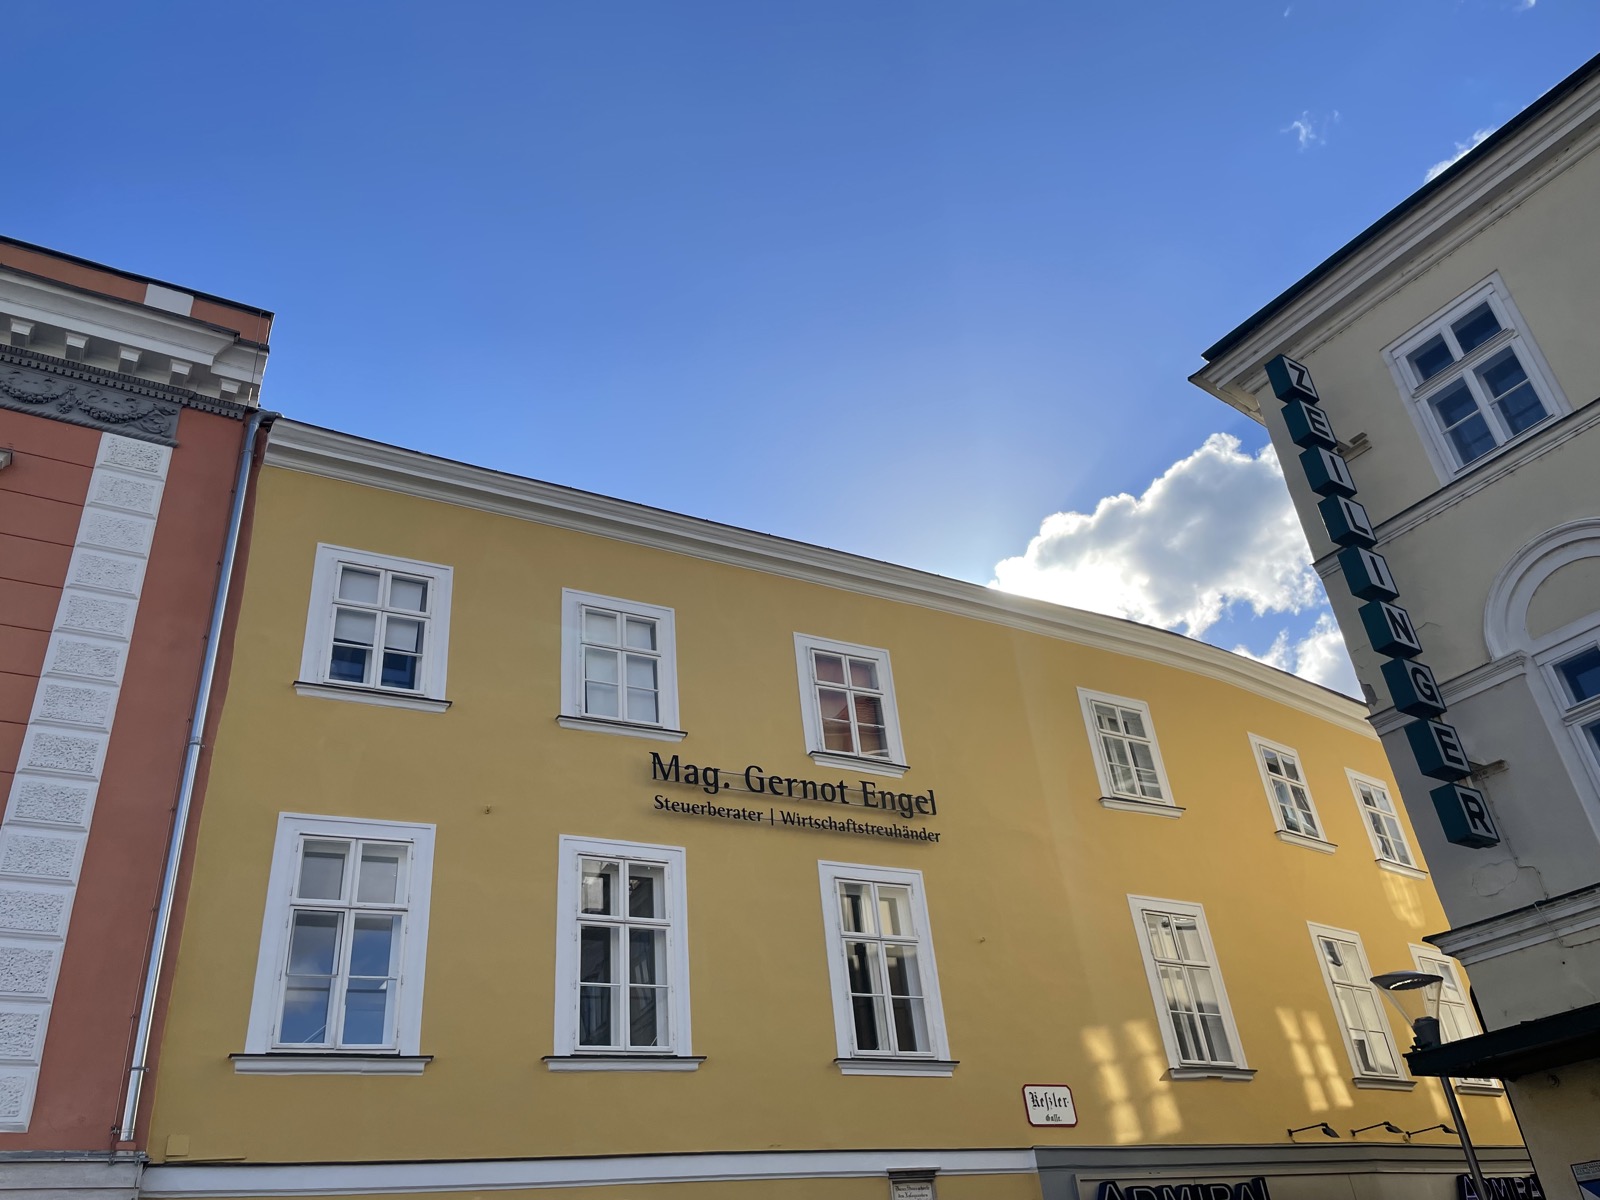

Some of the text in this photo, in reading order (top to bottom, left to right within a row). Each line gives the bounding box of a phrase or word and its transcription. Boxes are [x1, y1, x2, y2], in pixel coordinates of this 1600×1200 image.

[1287, 362, 1494, 836] ZEILINGER
[649, 752, 937, 819] Mag. Gernot Engel
[653, 795, 763, 822] Steuerberater
[780, 810, 941, 843] Wirtschaftstreuhänder
